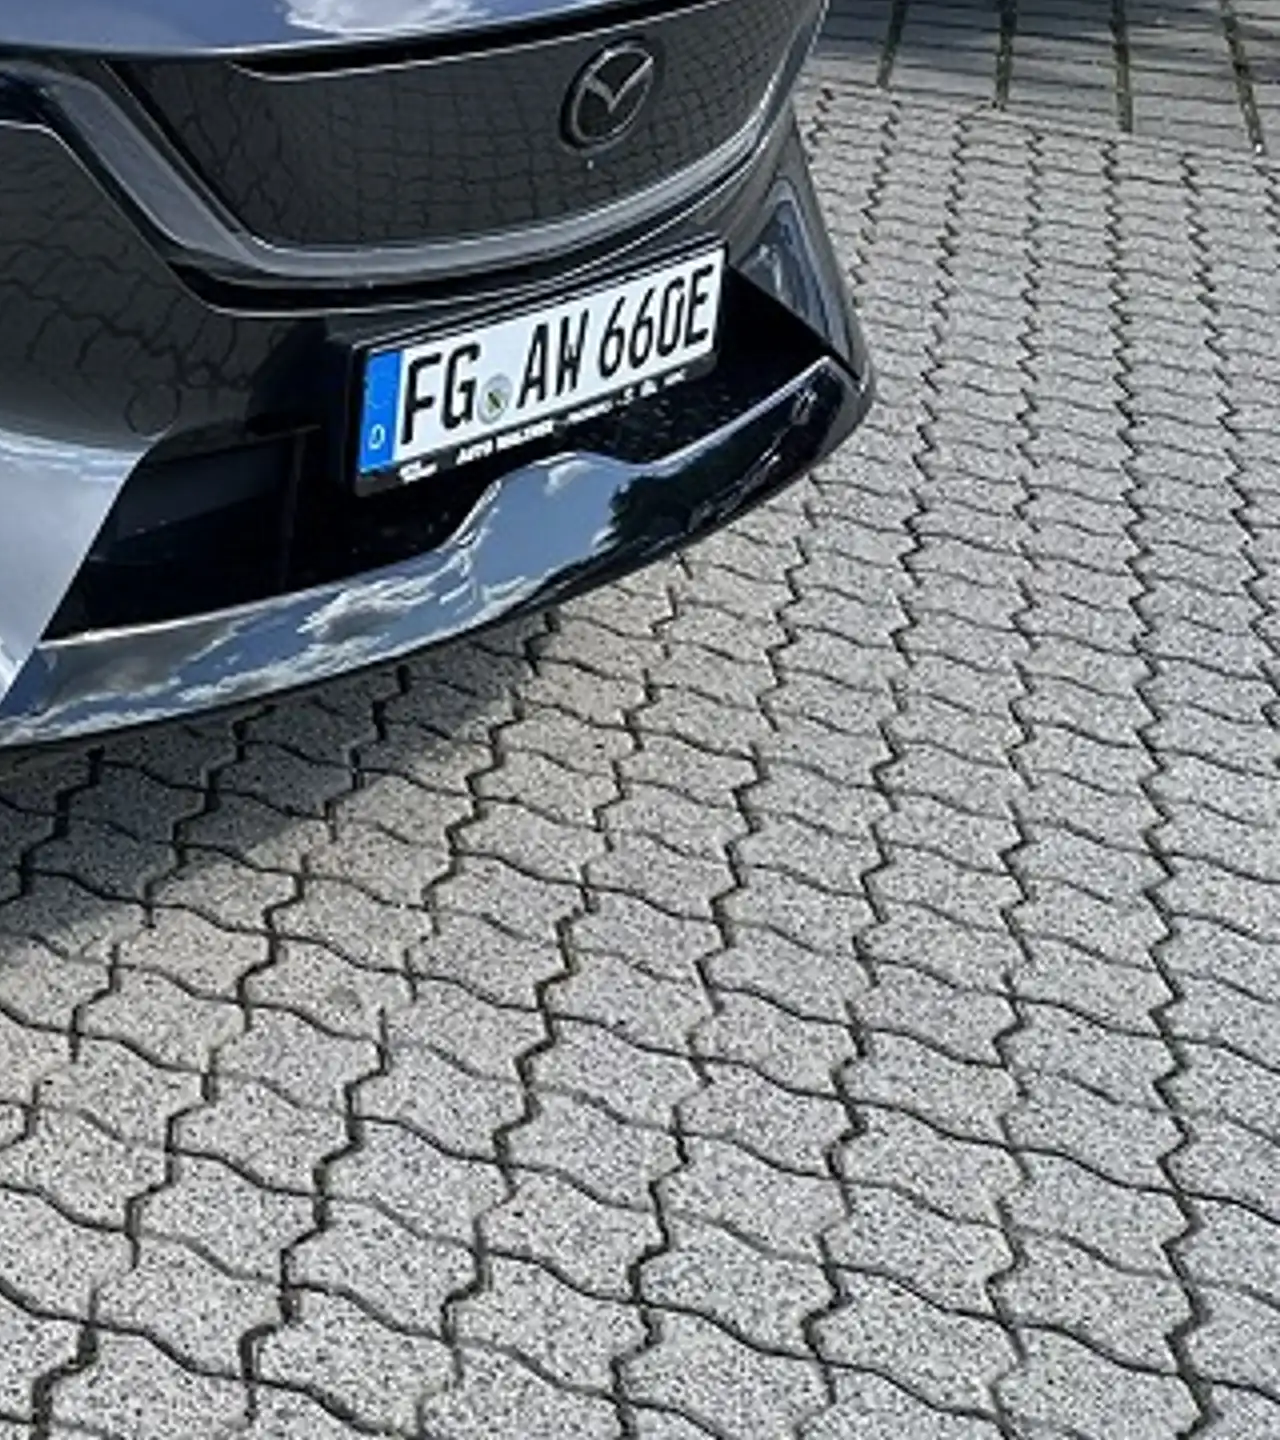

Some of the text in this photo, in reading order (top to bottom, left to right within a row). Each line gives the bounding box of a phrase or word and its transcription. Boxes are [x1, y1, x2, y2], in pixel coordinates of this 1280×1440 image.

[400, 341, 482, 446] FG
[516, 308, 590, 410] AW
[599, 263, 715, 379] 660E
